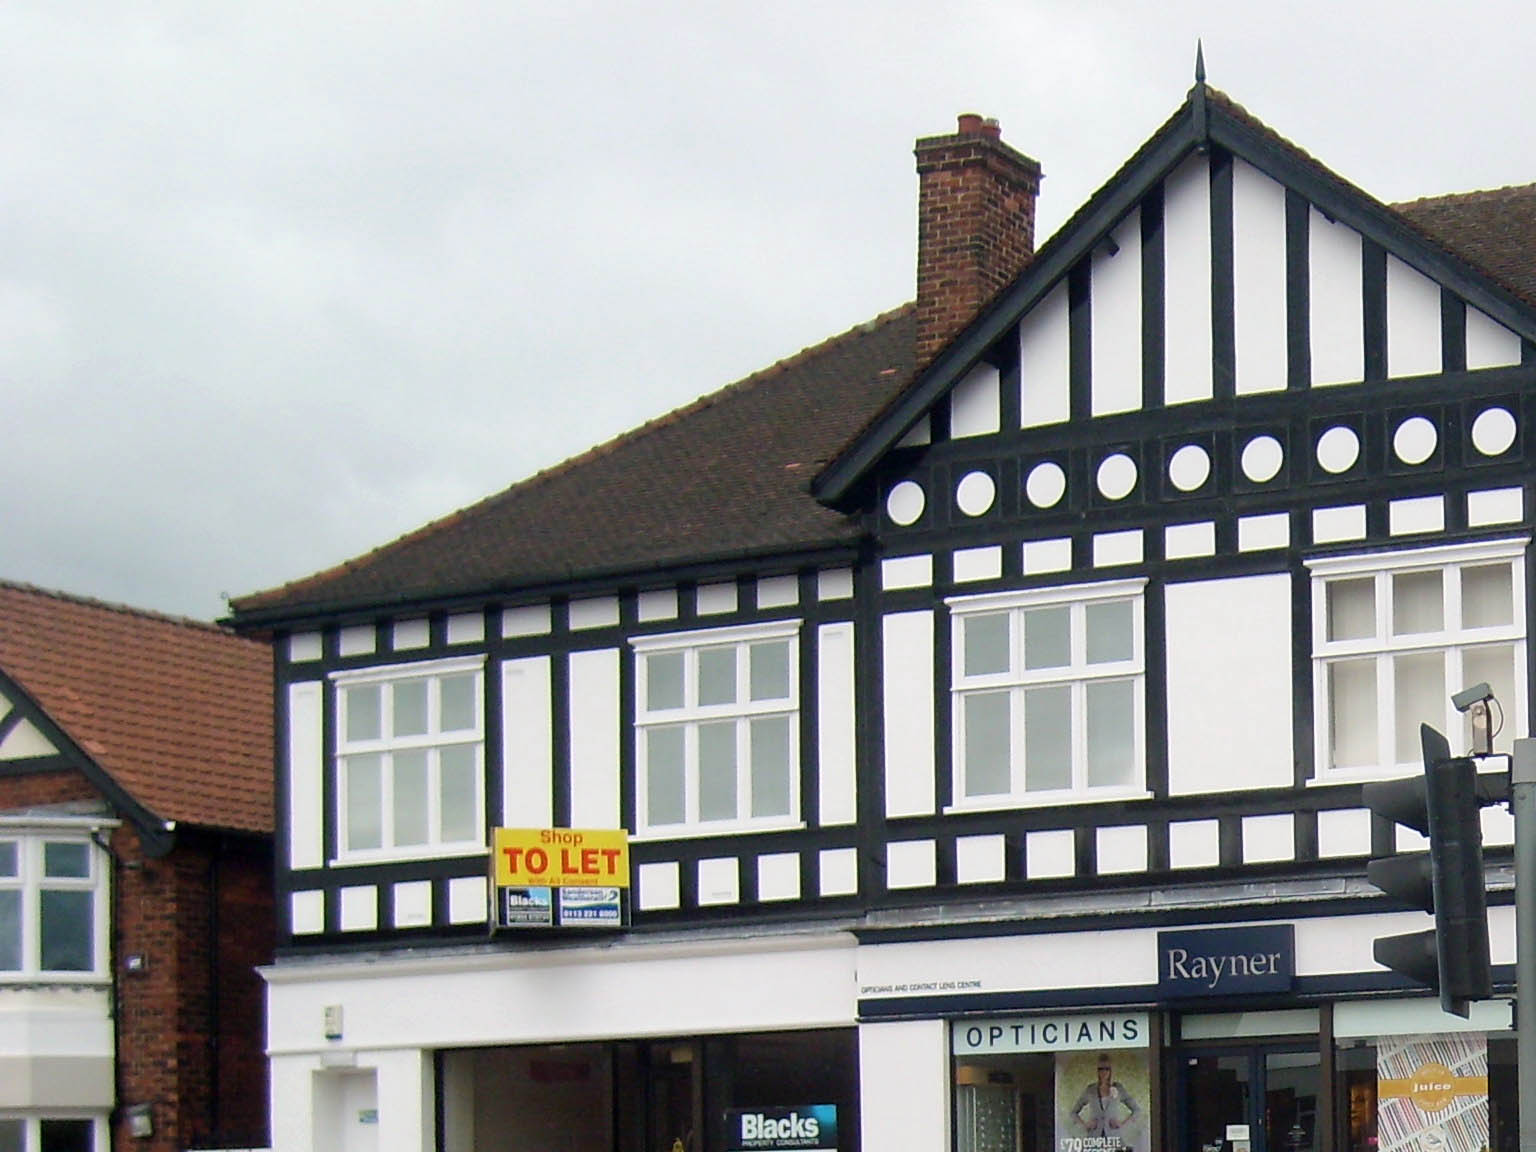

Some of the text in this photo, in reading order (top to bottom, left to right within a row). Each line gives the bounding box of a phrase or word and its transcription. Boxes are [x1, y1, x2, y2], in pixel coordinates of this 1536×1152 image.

[540, 829, 583, 848] Shop
[503, 847, 621, 875] TO LET
[1167, 949, 1281, 989] Rayner
[966, 1018, 1139, 1048] OPTICIANS
[1413, 1083, 1452, 1093] juice
[741, 1113, 819, 1140] Blacks
[1083, 1136, 1121, 1148] COMPLETE
